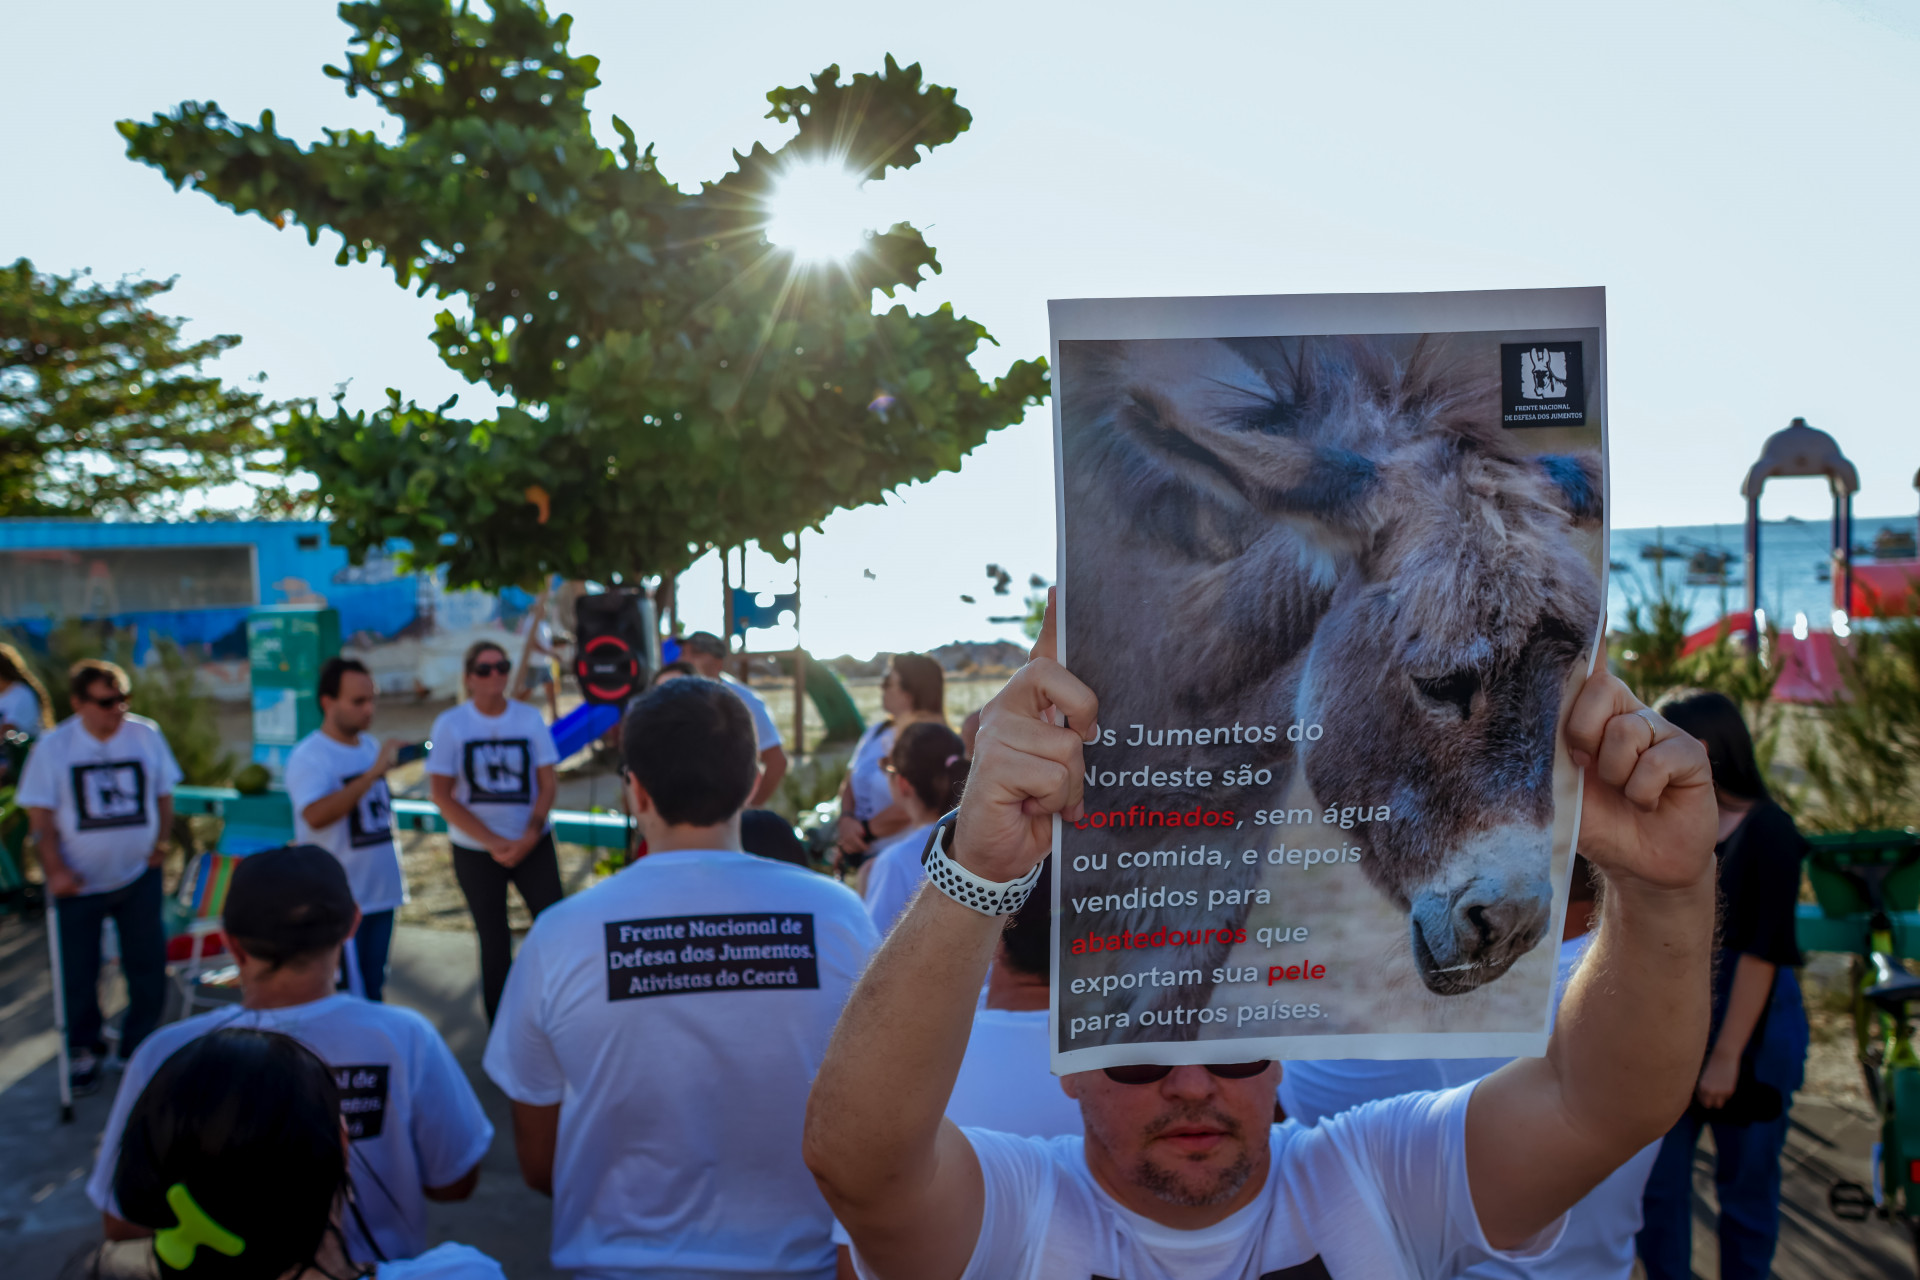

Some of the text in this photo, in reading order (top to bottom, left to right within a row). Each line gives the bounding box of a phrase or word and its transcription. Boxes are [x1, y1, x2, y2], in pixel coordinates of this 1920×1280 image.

[1126, 721, 1277, 747] Jumentos
[1286, 719, 1324, 742] do
[1221, 764, 1273, 787] são
[1253, 805, 1313, 826] sem
[1322, 802, 1391, 830] água
[1072, 842, 1362, 872] ou comida, e depois
[1071, 886, 1271, 914] vendidos para
[619, 917, 803, 943] Frente Nacional de
[1071, 925, 1309, 955] abatedouros que
[609, 948, 677, 970] Defesa
[680, 944, 715, 963] dos
[628, 966, 799, 994] Ativistas do Ceará
[1070, 959, 1326, 997] exportam sua pele
[1070, 999, 1329, 1039] para outros países.
